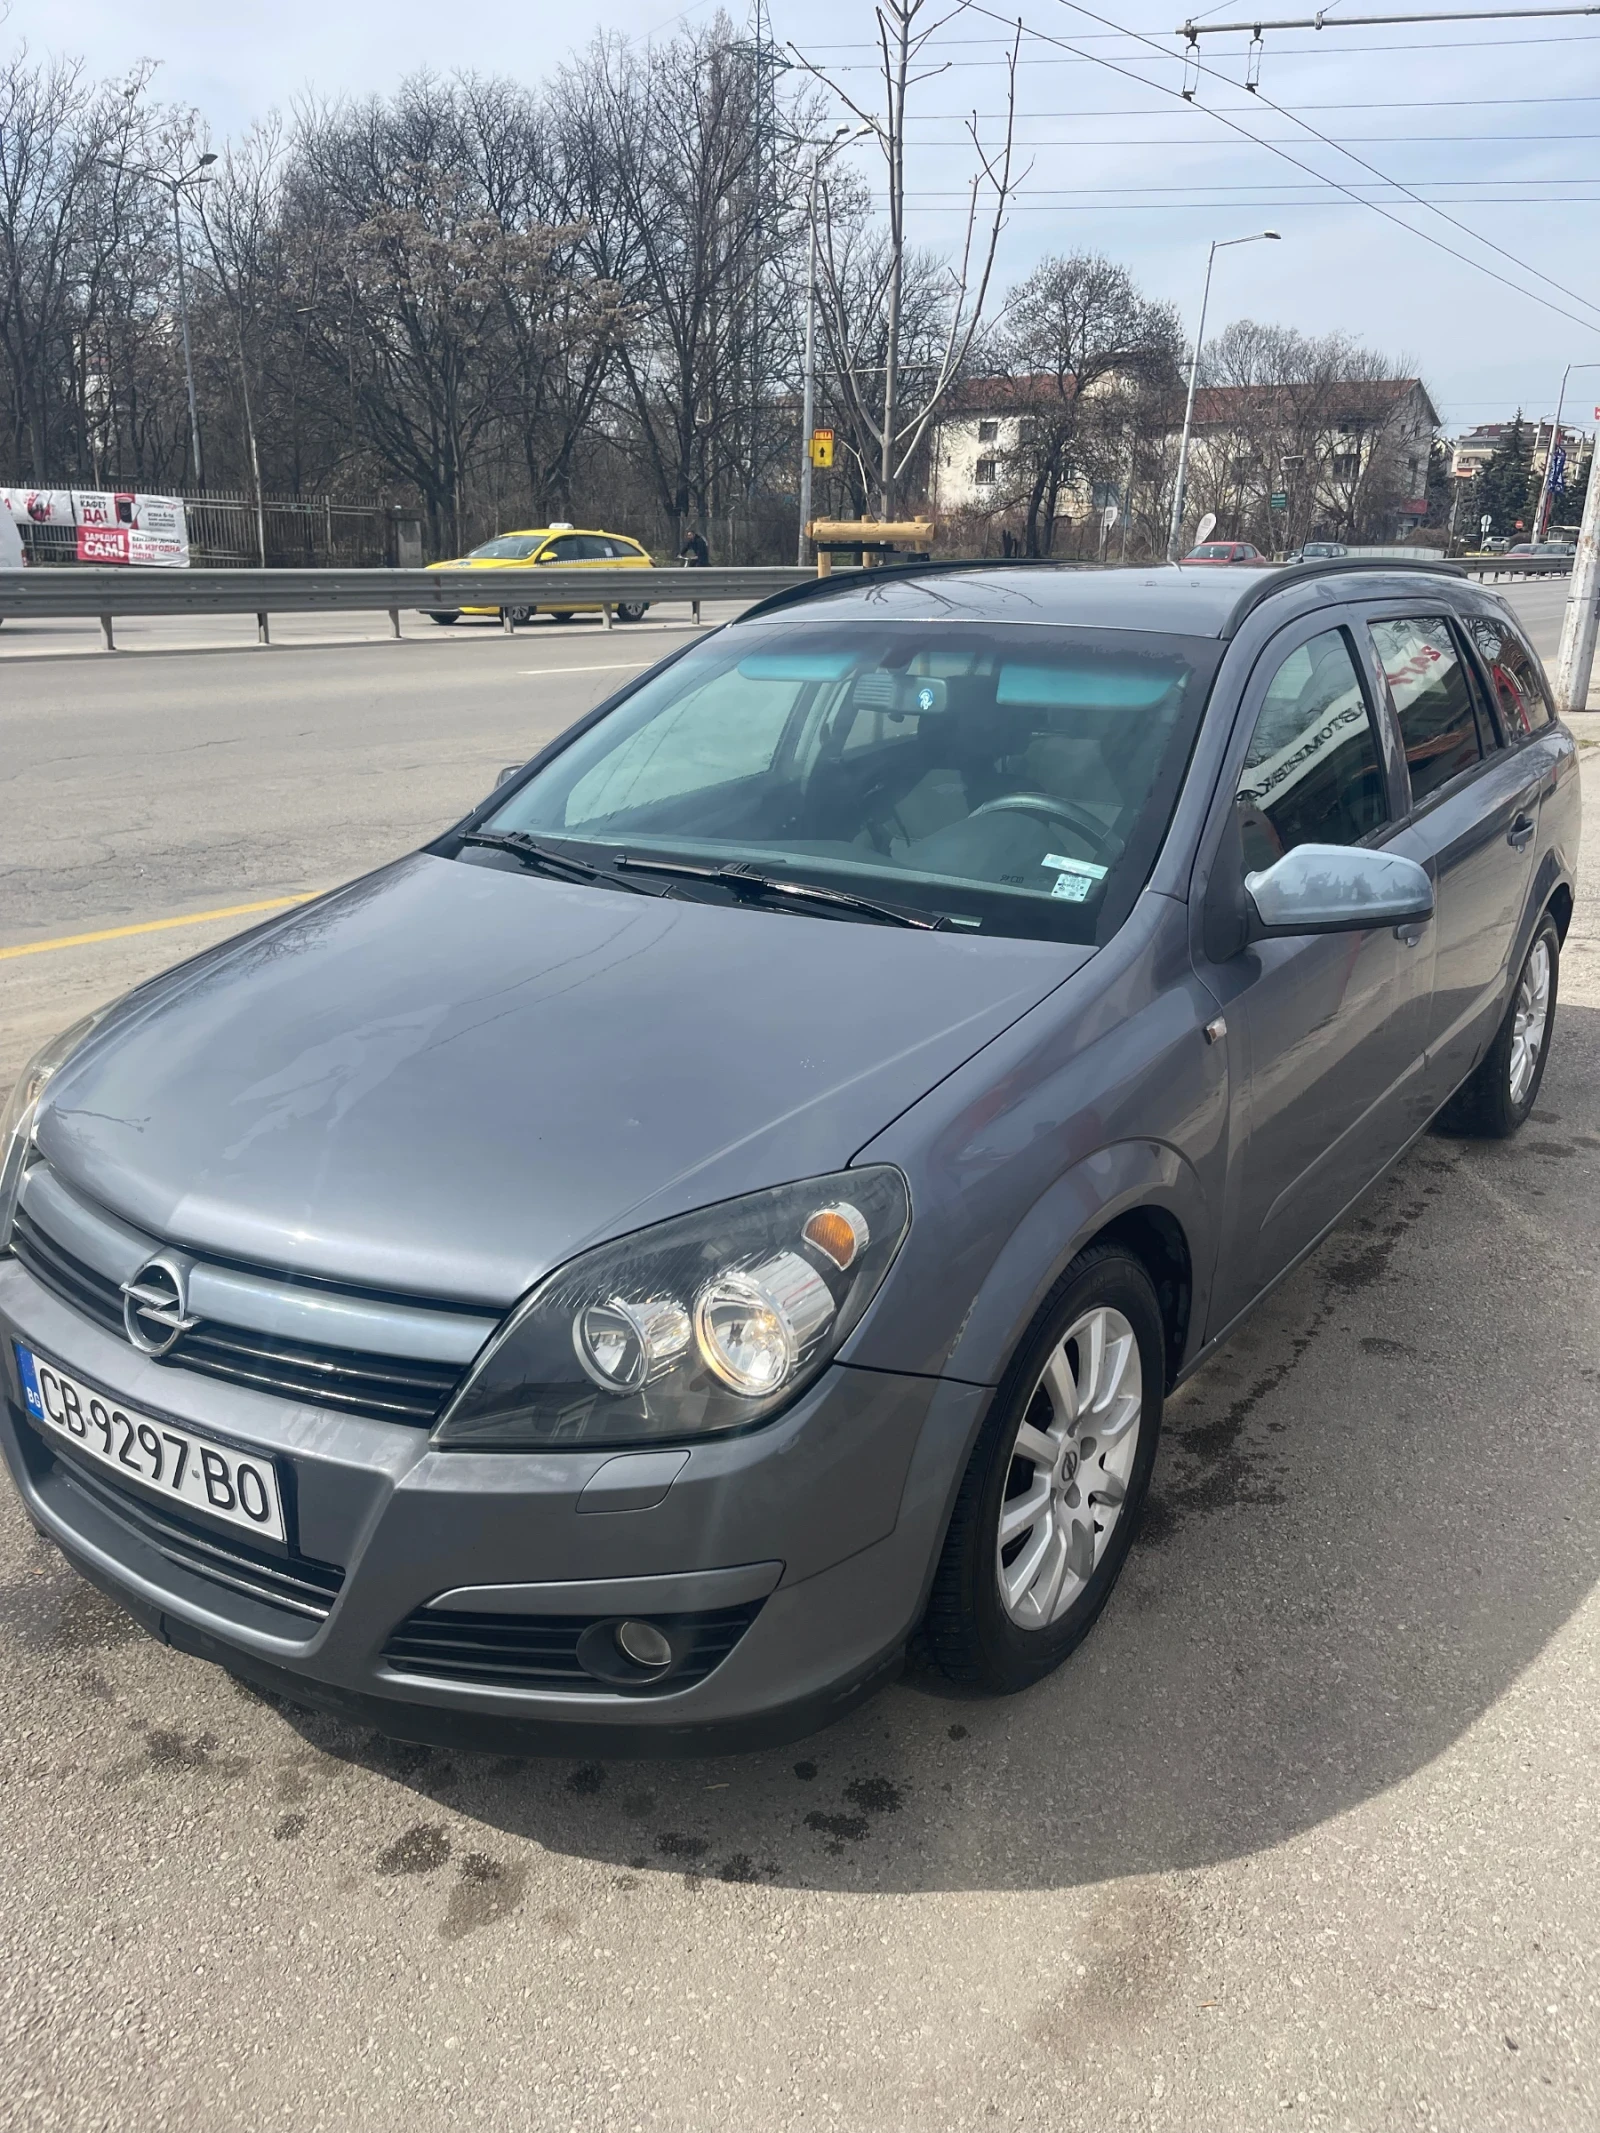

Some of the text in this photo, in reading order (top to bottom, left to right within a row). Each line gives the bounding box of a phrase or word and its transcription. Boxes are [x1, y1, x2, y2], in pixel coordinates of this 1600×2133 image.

[80, 500, 107, 509] КАФЕ?
[83, 508, 109, 524] ДА!
[26, 1386, 42, 1409] BG
[40, 1367, 271, 1523] CB 9297 BO
